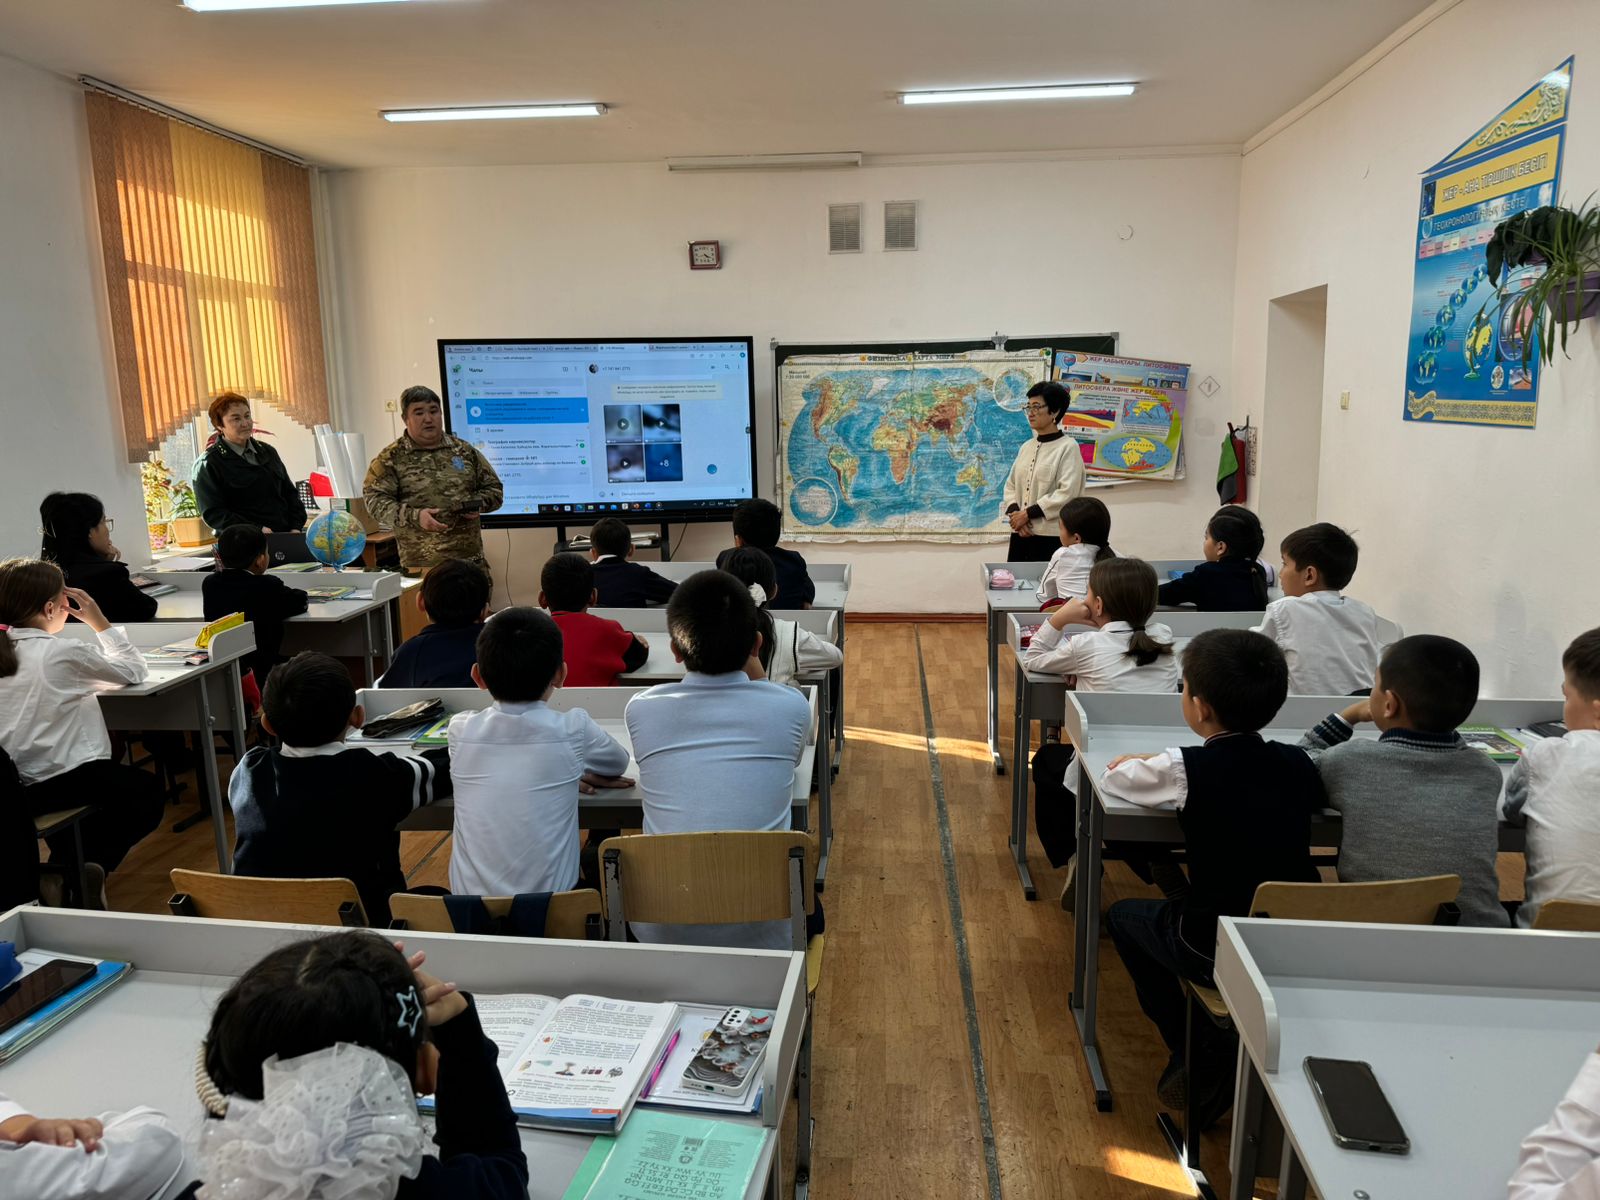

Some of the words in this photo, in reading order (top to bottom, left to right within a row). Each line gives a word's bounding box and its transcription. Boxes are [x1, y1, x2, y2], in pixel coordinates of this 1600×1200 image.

[1074, 384, 1111, 392] ЛИТОСФЕРА
[1130, 388, 1144, 396] ЖЕР
[660, 459, 669, 468] +8
